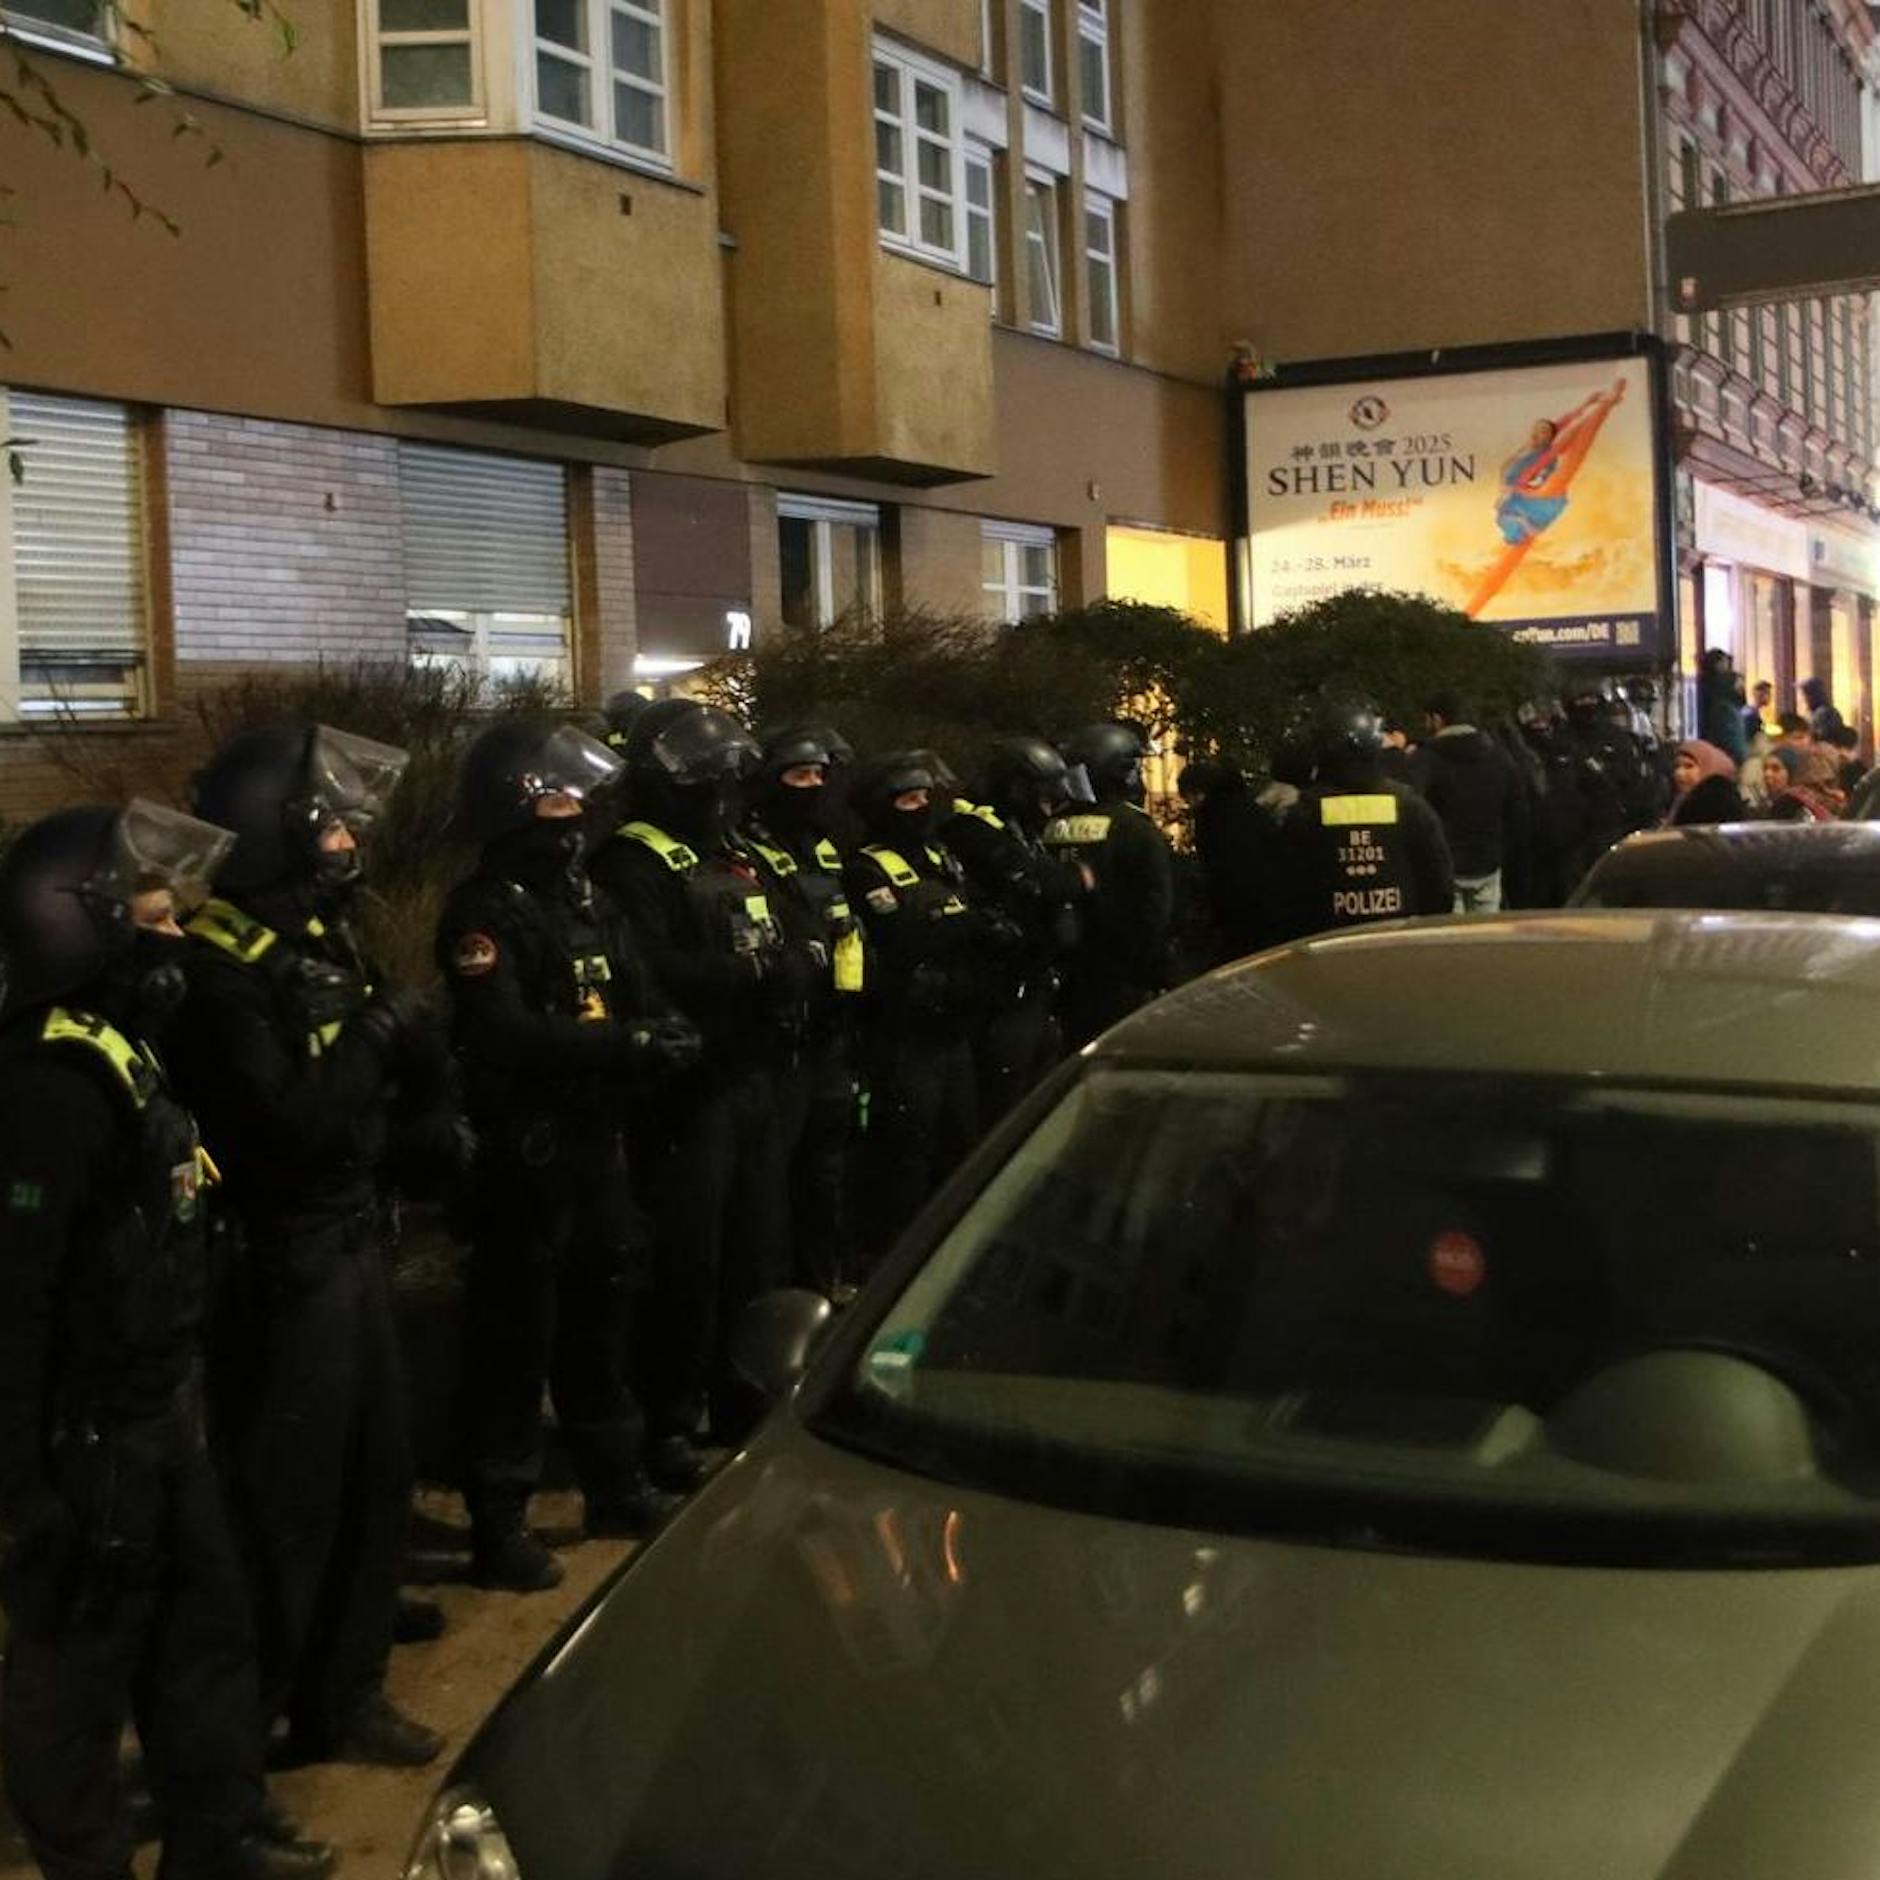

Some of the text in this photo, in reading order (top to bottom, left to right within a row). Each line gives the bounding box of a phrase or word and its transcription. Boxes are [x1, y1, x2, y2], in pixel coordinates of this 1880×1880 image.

[1403, 433, 1453, 455] 2025
[1268, 454, 1476, 497] SHEN YUN
[1333, 553, 1371, 569] März
[726, 612, 751, 649] 79
[1333, 886, 1401, 916] POLIZEI
